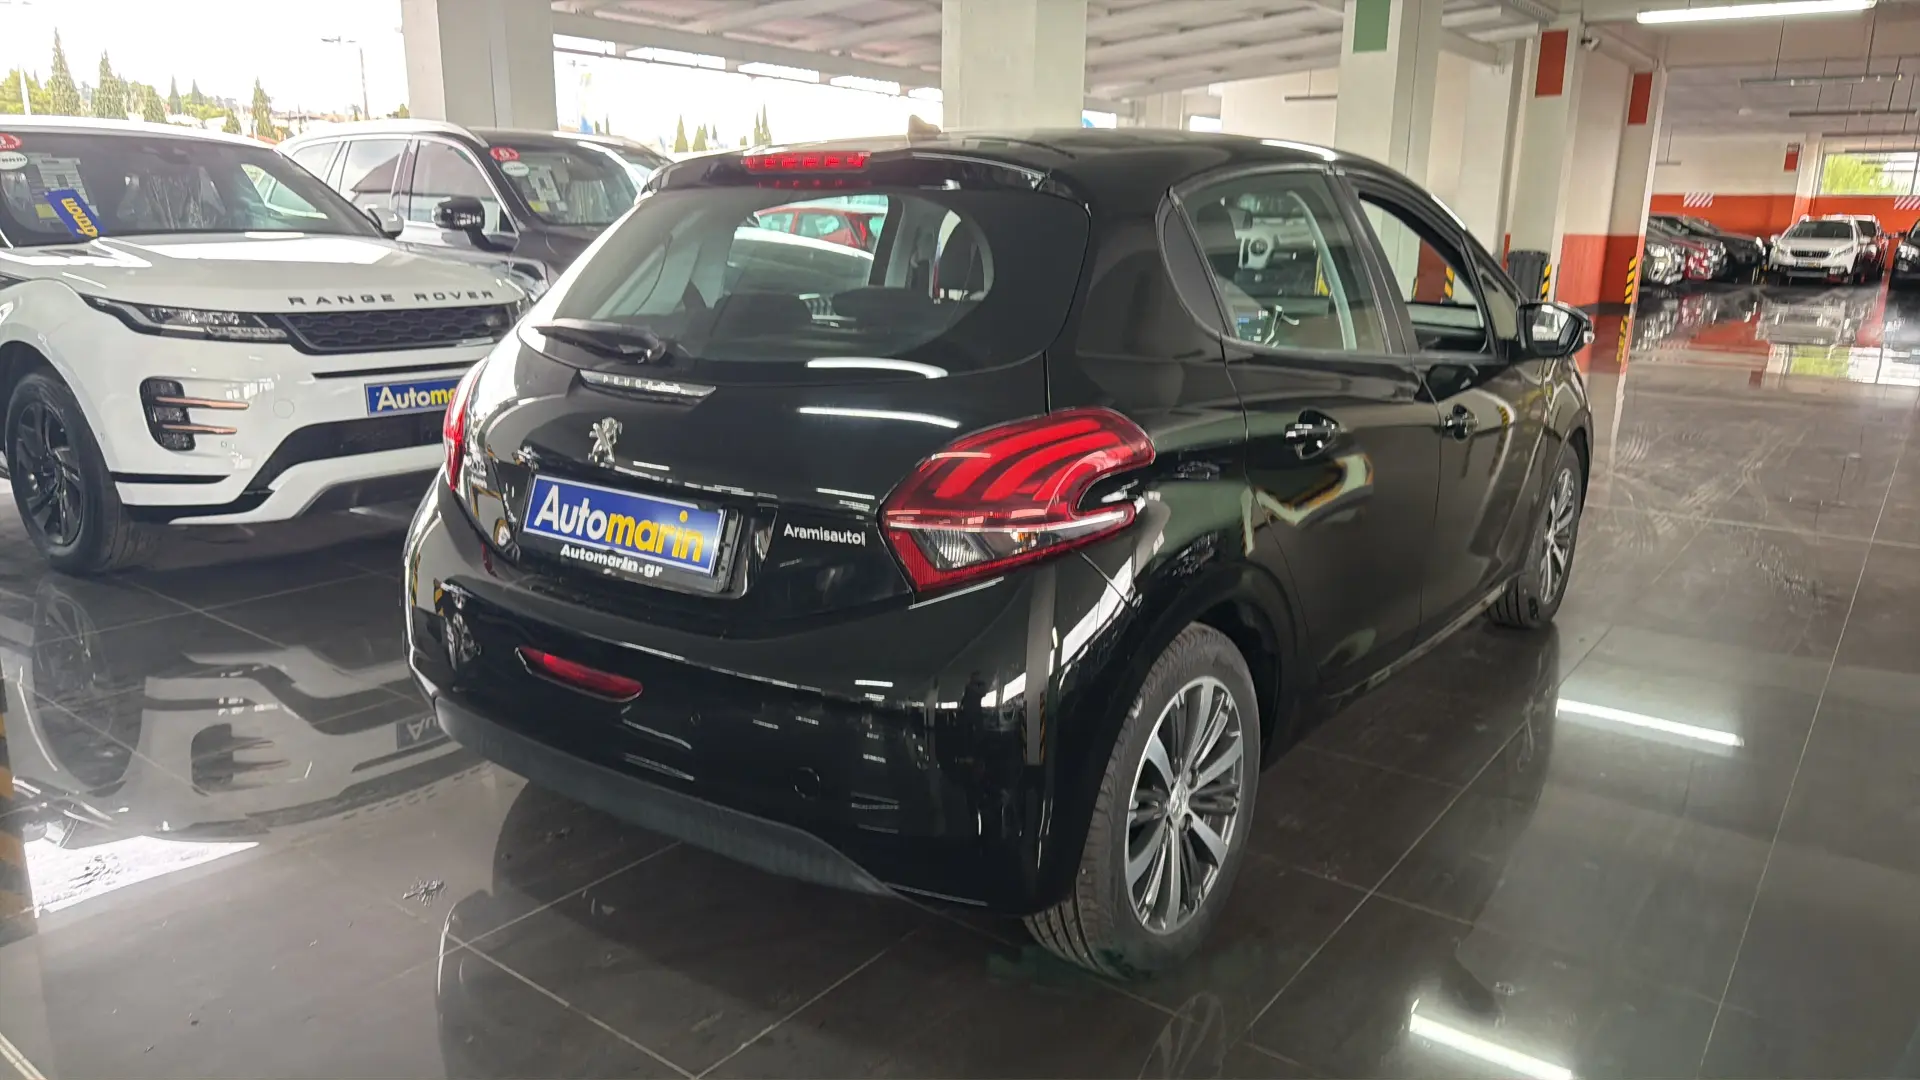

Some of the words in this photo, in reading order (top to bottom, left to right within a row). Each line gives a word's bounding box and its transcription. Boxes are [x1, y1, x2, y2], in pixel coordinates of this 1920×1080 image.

[287, 292, 396, 307] RANGE
[413, 290, 494, 302] ROVER
[534, 484, 704, 563] Automarin
[560, 543, 663, 577] Automarin.gr
